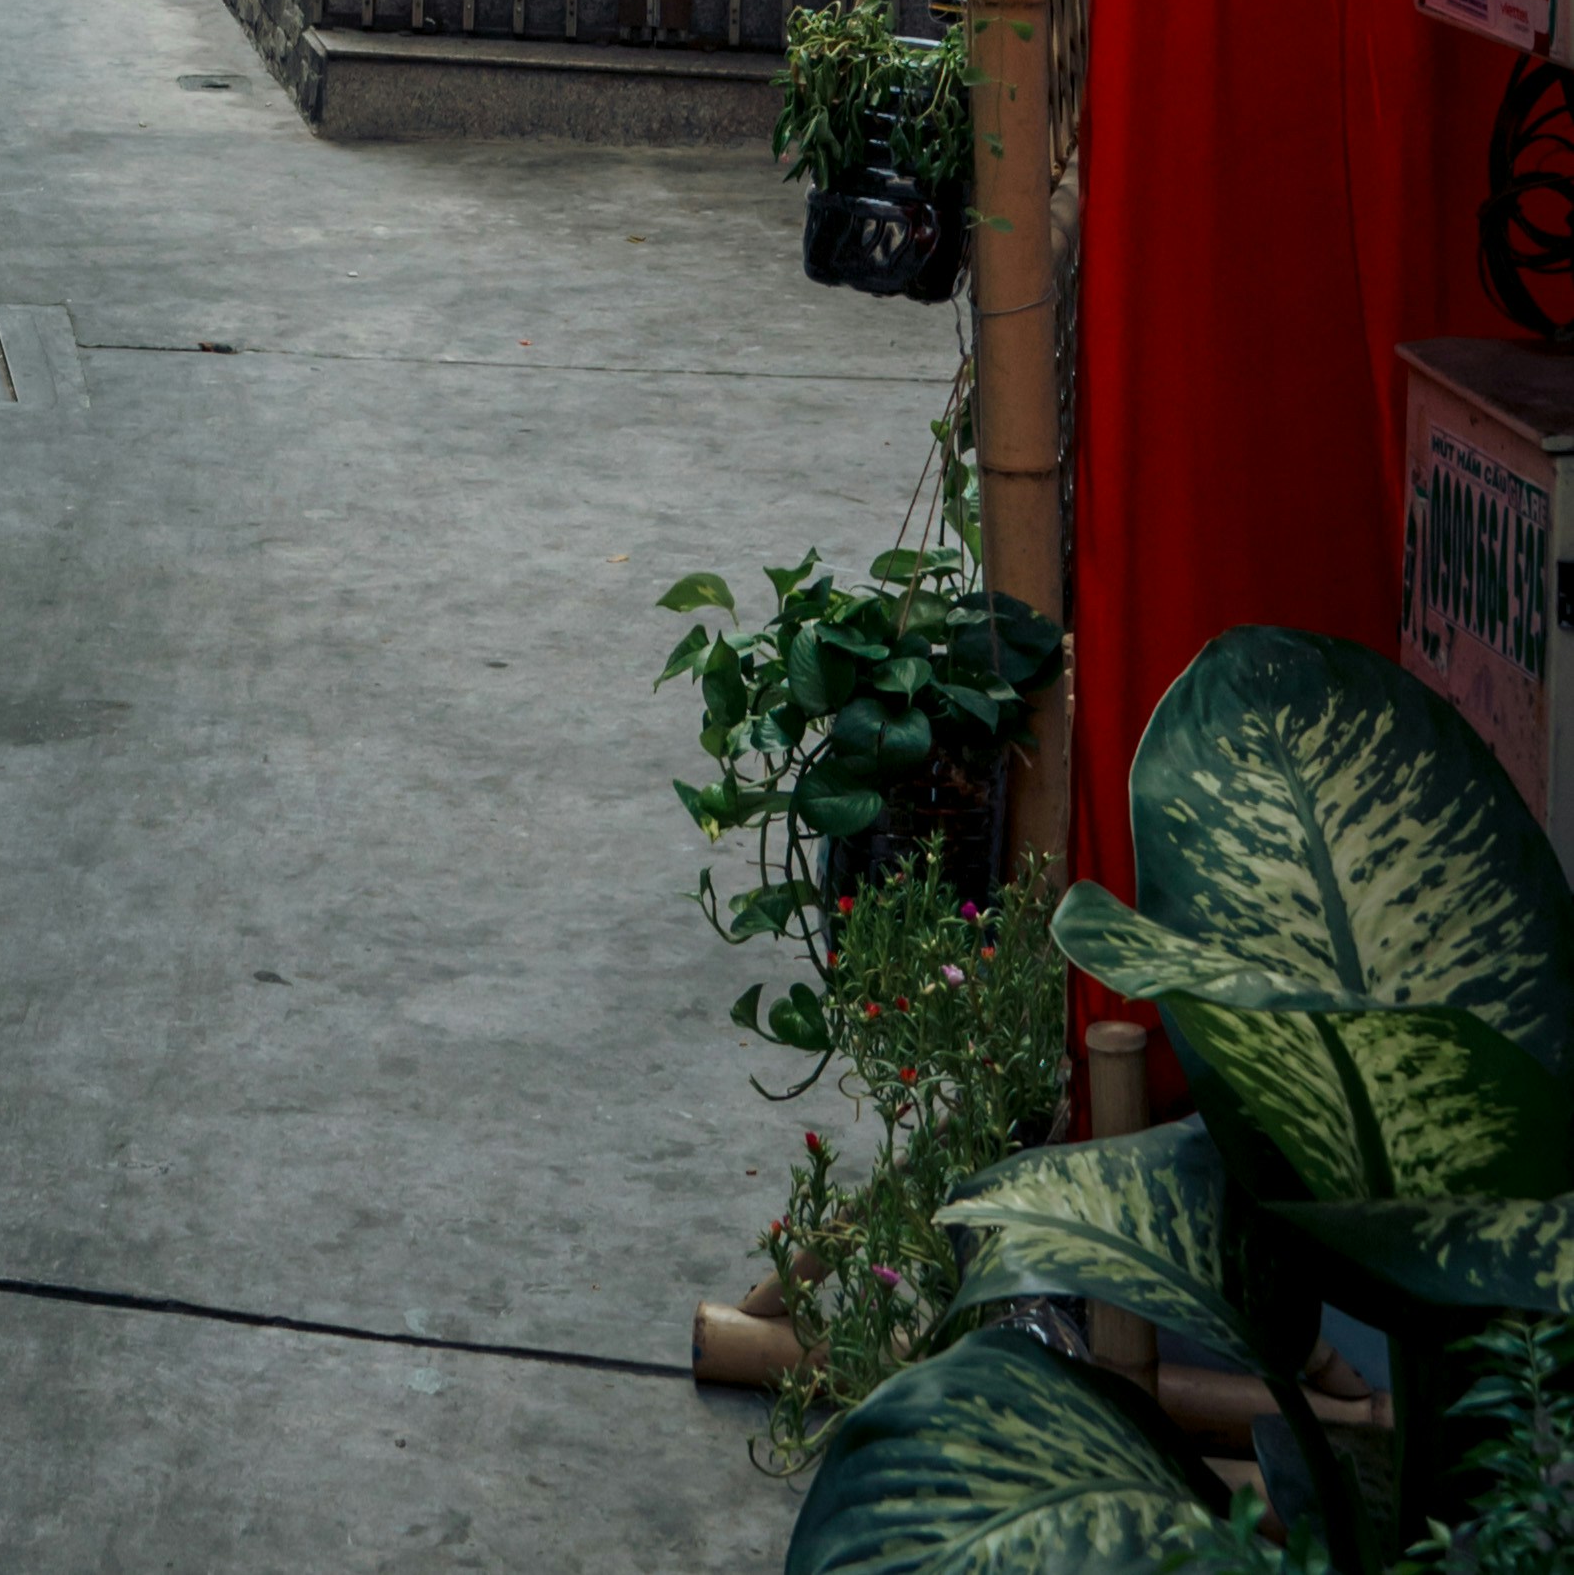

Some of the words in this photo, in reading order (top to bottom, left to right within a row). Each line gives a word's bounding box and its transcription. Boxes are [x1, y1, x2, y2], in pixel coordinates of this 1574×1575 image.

[1432, 433, 1455, 464] HÚT
[1457, 447, 1481, 481] HẦM
[1484, 462, 1507, 495] CẦU
[1431, 464, 1546, 683] 0909.664.525
